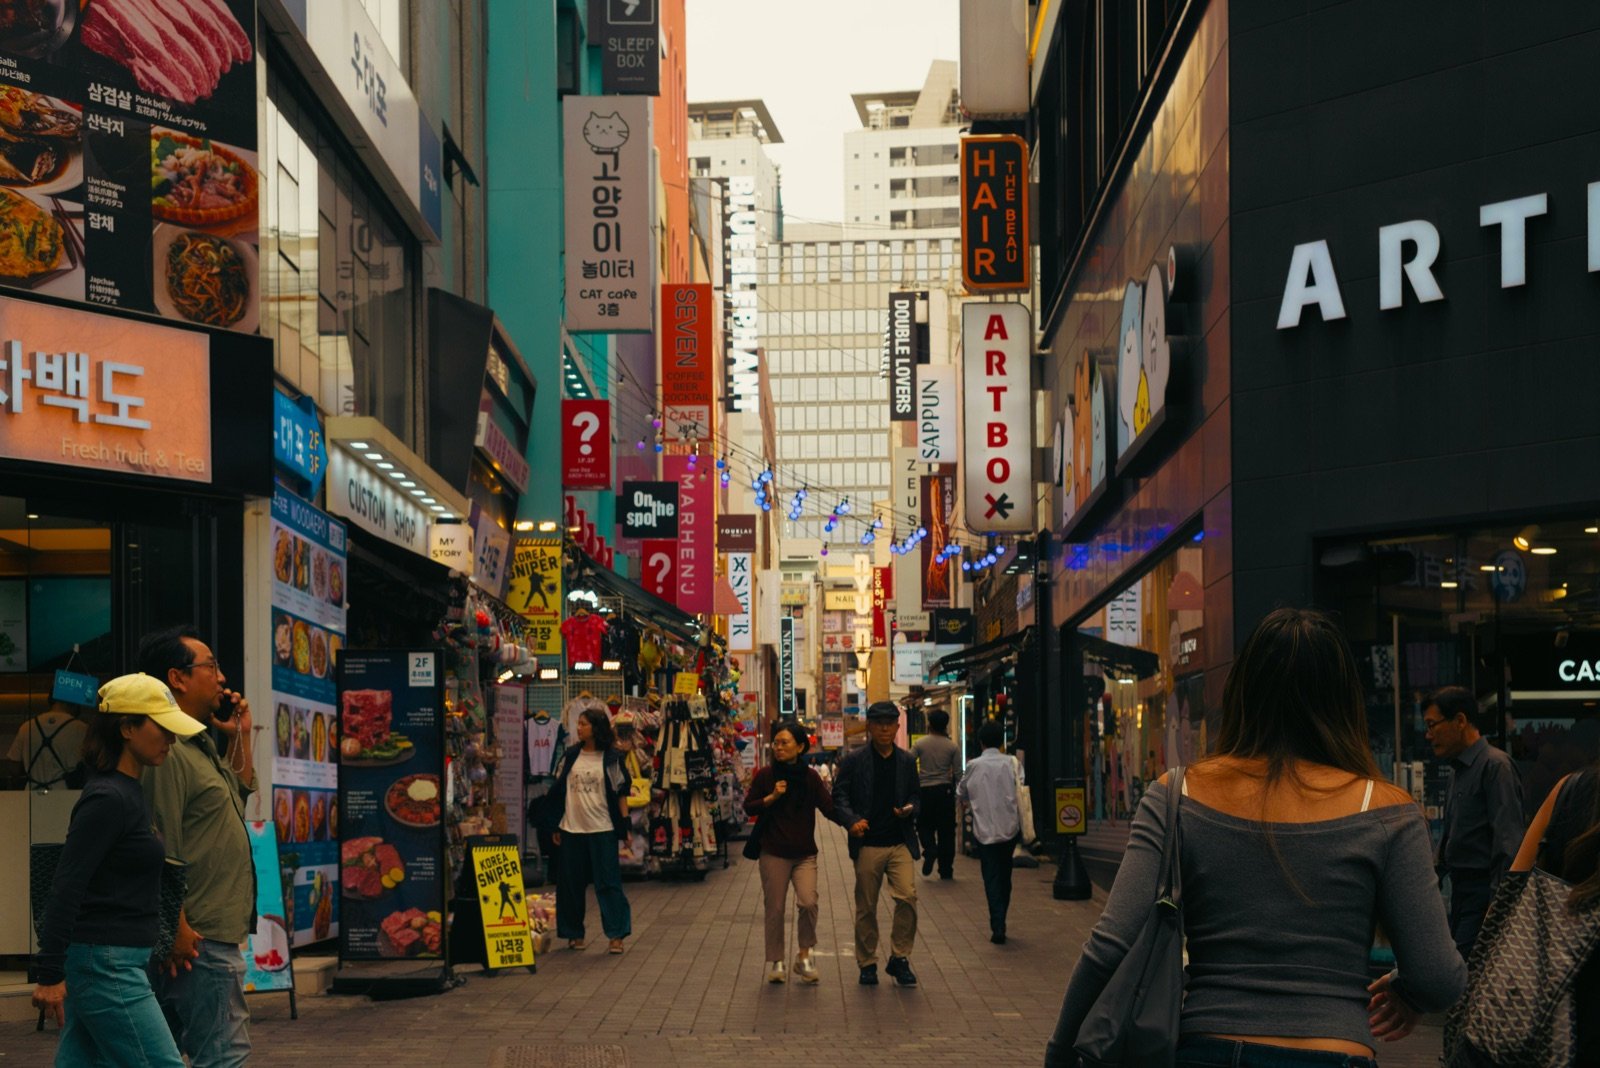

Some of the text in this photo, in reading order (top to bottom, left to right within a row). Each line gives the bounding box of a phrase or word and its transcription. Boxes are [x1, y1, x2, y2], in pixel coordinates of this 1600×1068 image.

[608, 38, 654, 51] SLEEP
[617, 54, 645, 67] BOX
[351, 32, 388, 128] 우대포
[88, 82, 132, 111] 삼겹살
[136, 94, 171, 112] Pork belly
[87, 113, 125, 137] 산낙지
[87, 176, 126, 192] Live Octopus
[592, 151, 622, 252] 고양이
[1005, 161, 1017, 263] THE BEAU
[88, 212, 114, 233] 잡채
[972, 150, 998, 276] HAIR
[1276, 181, 1600, 330] ART
[582, 260, 634, 279] 놀이터
[579, 288, 637, 299] CAT cafe
[729, 176, 759, 412] BLUE ELEPHANT
[597, 303, 619, 316] 3층
[675, 288, 697, 368] SEVEN
[894, 299, 912, 414] DOUBLE LOVERS
[666, 371, 705, 381] COFFEE
[673, 382, 698, 391] BEER
[663, 392, 709, 402] COCKTAIL
[669, 410, 705, 421] CAFE
[922, 379, 939, 459] SAPPUN
[984, 314, 1014, 521] ARTBOX
[273, 415, 305, 467] 대포
[309, 429, 320, 451] 2F
[62, 437, 205, 473] Fresh fruit & Tea
[309, 454, 320, 475] 3F
[633, 491, 675, 517] On the
[906, 459, 916, 527] ZEUS
[348, 478, 387, 530] CUSTOM
[394, 508, 416, 547] SHOP
[439, 537, 456, 546] MY
[431, 549, 462, 559] STORY
[415, 657, 429, 668] 2F
[783, 630, 792, 701] NICK NICOLE
[58, 676, 83, 689] OPEN
[479, 852, 509, 871] KOREA
[477, 860, 520, 888] SNIPER
[495, 938, 525, 954] 사격장
